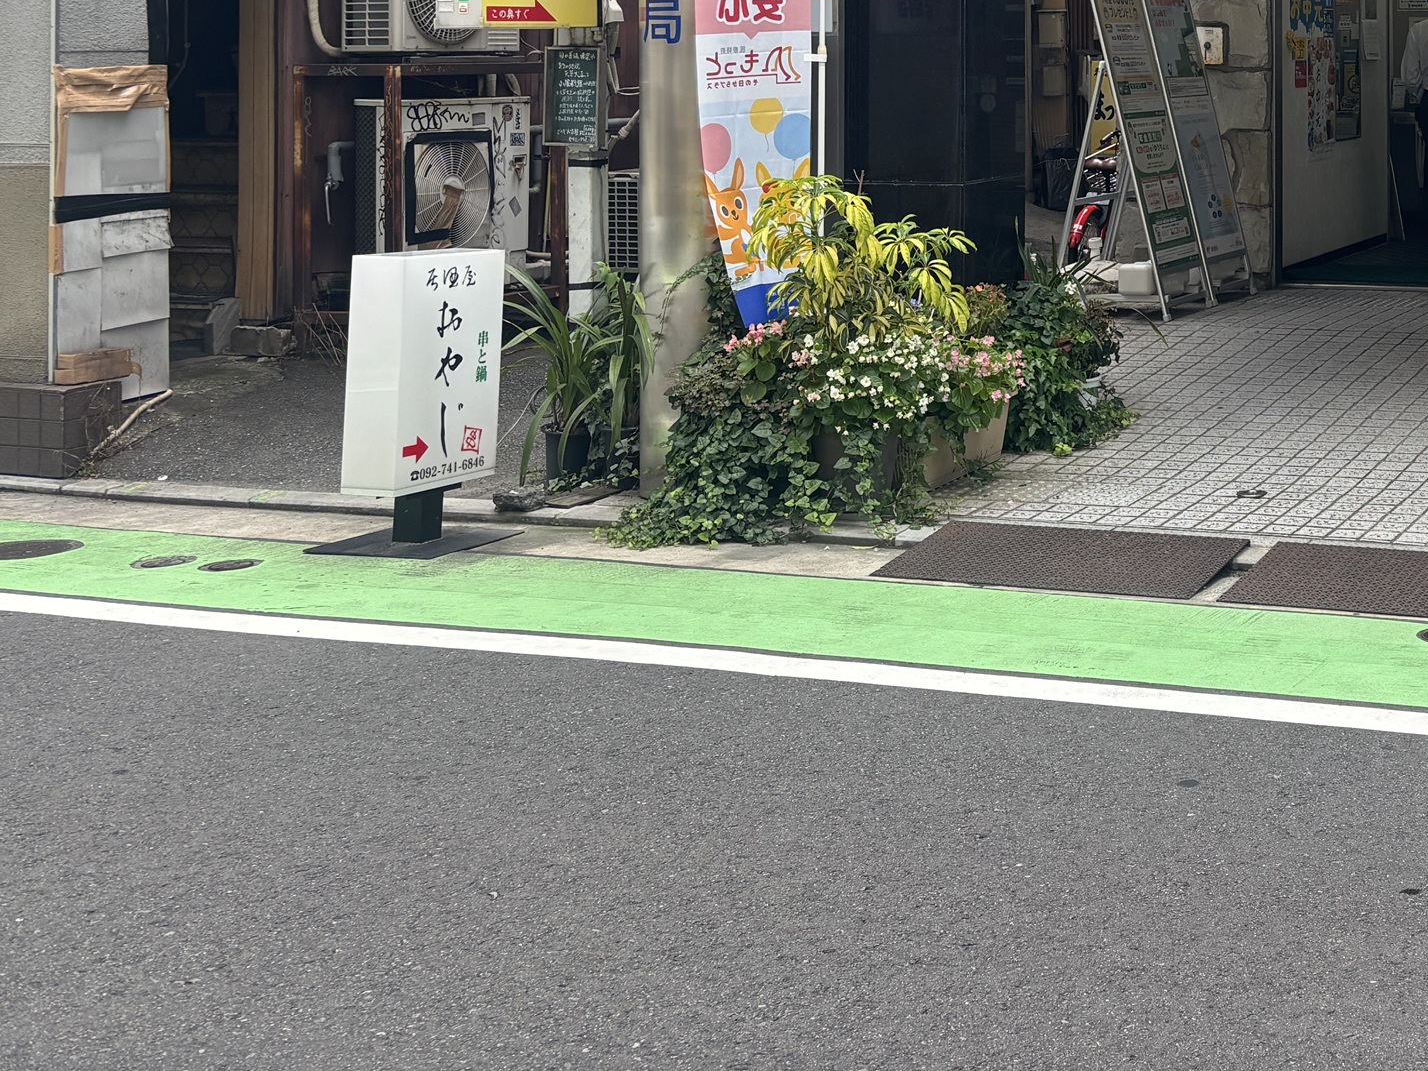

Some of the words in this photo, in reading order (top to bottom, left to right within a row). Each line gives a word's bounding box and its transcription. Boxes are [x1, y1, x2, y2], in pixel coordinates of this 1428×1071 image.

[491, 8, 530, 20] この奥すぐ
[475, 330, 489, 382] 串と鍋
[434, 300, 464, 458] おやじ
[420, 455, 485, 480] 092-741-6846
